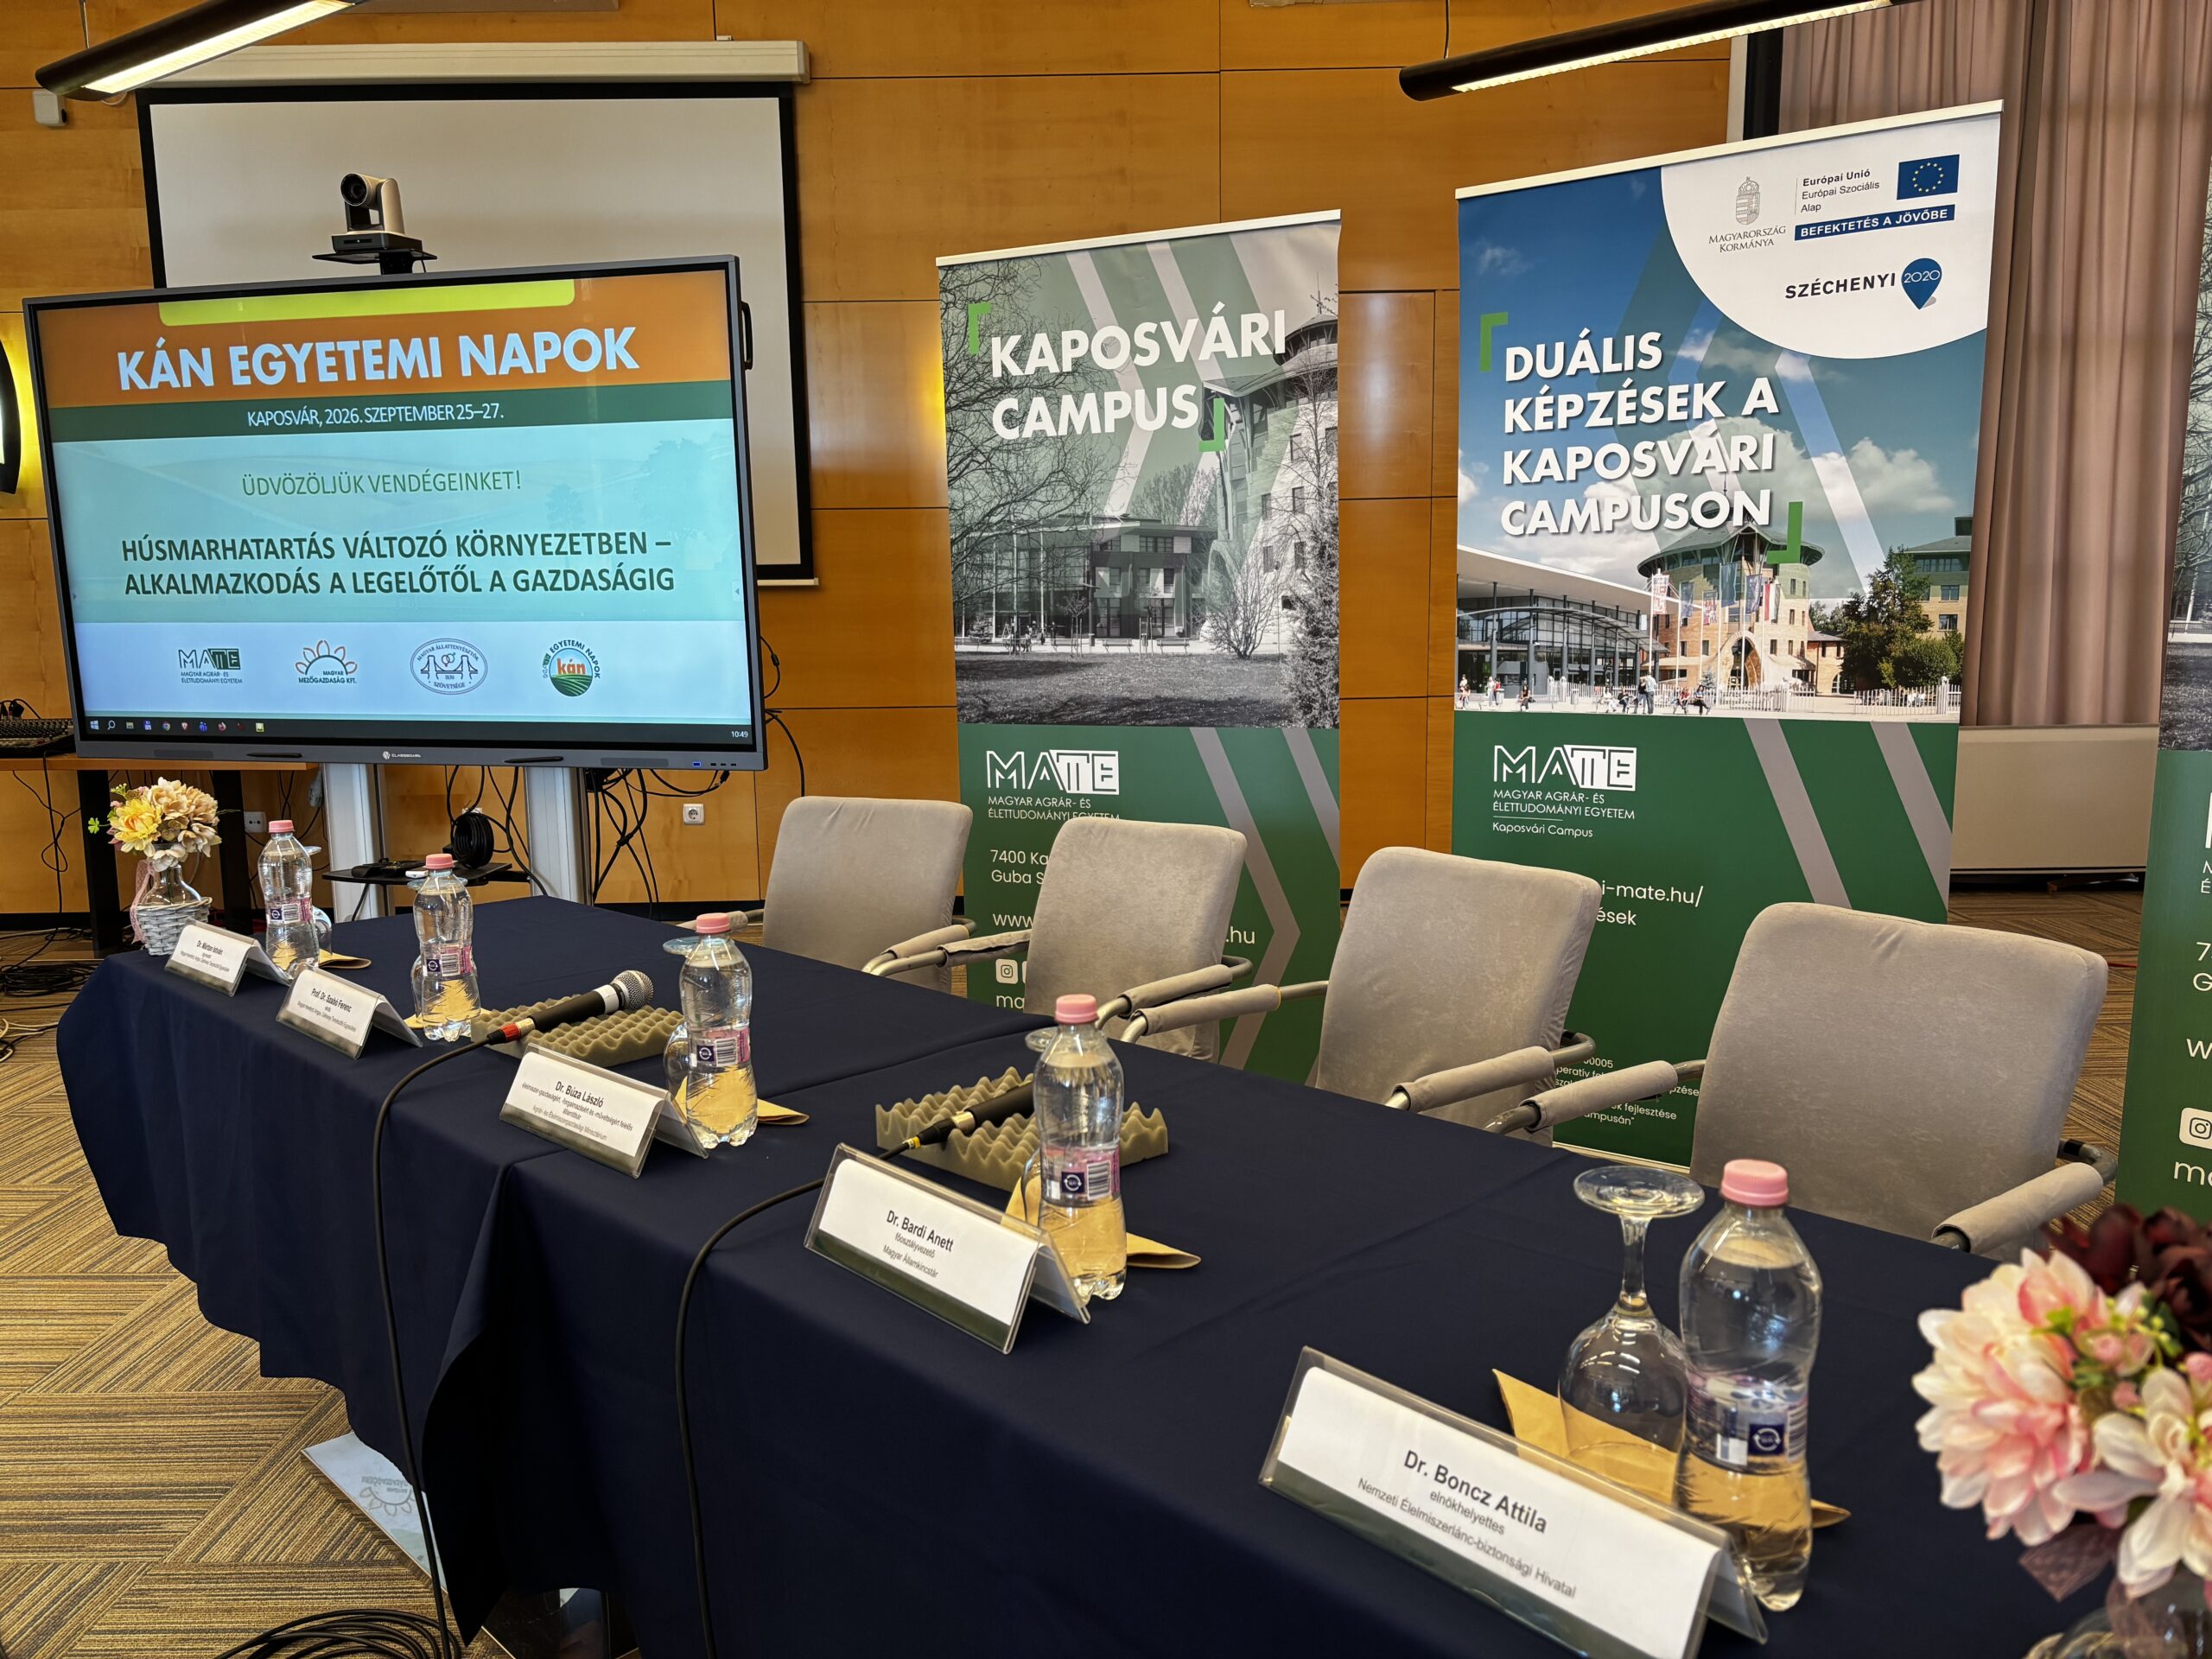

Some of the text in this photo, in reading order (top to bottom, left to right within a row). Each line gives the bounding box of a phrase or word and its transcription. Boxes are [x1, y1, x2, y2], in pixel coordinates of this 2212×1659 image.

[1802, 168, 1871, 188] Európai Unió
[1802, 181, 1879, 201] Európai Szociális
[1801, 203, 1821, 214] Alap
[1708, 225, 1786, 244] MAGYARORSZÁG
[1800, 207, 1948, 238] BEFEKTETÉS A JÖVŐBE
[1719, 238, 1774, 253] KORMÁNYA
[1785, 270, 1941, 300] SZÉCHENYI 2020
[991, 301, 1287, 378] KAPOSVÁRI
[118, 327, 640, 391] KÁN EGYETEMI NAPOK
[1505, 327, 1662, 382] DUÁLIS
[247, 405, 323, 428] KAPOSVÁR,
[326, 408, 363, 424] 2026.
[365, 404, 455, 423] SZEPTEMBER
[992, 384, 1200, 440] CAMPUS
[1504, 377, 1779, 434] KÉPZÉSEK A
[1503, 429, 1775, 485] KAPOSVÁRI
[242, 468, 522, 495] ÜDVÖZÖLJÜK VENDÉGEINKET!
[1501, 489, 1771, 536] CAMPUSON
[122, 531, 335, 561] HÚSMARHATARTÁS
[342, 530, 447, 558] VÁLTOZÓ
[456, 529, 647, 556] KÖRNYEZETBEN
[125, 562, 675, 594] ALKALMAZKODÁS A LEGELŐTŐL A GAZDASÁGIG
[178, 648, 241, 670] MATE
[556, 658, 586, 676] kán
[987, 749, 1120, 795] MATE
[1494, 744, 1637, 791] MATE
[988, 796, 1091, 809] MAGYAR AGRÁR- ÉS
[1492, 801, 1635, 819] ÉLETTUDOMÁNYI EGYETEM
[1493, 789, 1605, 804] MAGYAR AGRÁR- ÉS
[988, 807, 1070, 821] ÉLETTUDOMÁNYI
[1492, 822, 1593, 838] Kaposvári Campus
[990, 849, 1026, 864] 7400
[991, 869, 1032, 884] Guba
[338, 1000, 352, 1013] Ferenc
[555, 1081, 604, 1108] Dr. Búza László
[1624, 1103, 1677, 1120] fejlesztése
[887, 1210, 954, 1252] Dr. Bardi Anett
[895, 1232, 936, 1259] főosztályvezető
[882, 1244, 939, 1279] Magyar Államkincstár
[1403, 1450, 1548, 1534] Dr. Boncz Attila
[1429, 1490, 1505, 1535] elnökhelyettes
[1357, 1478, 1577, 1599] Nemzeti Élelmiszerlánc-biztonsági Hivatal
